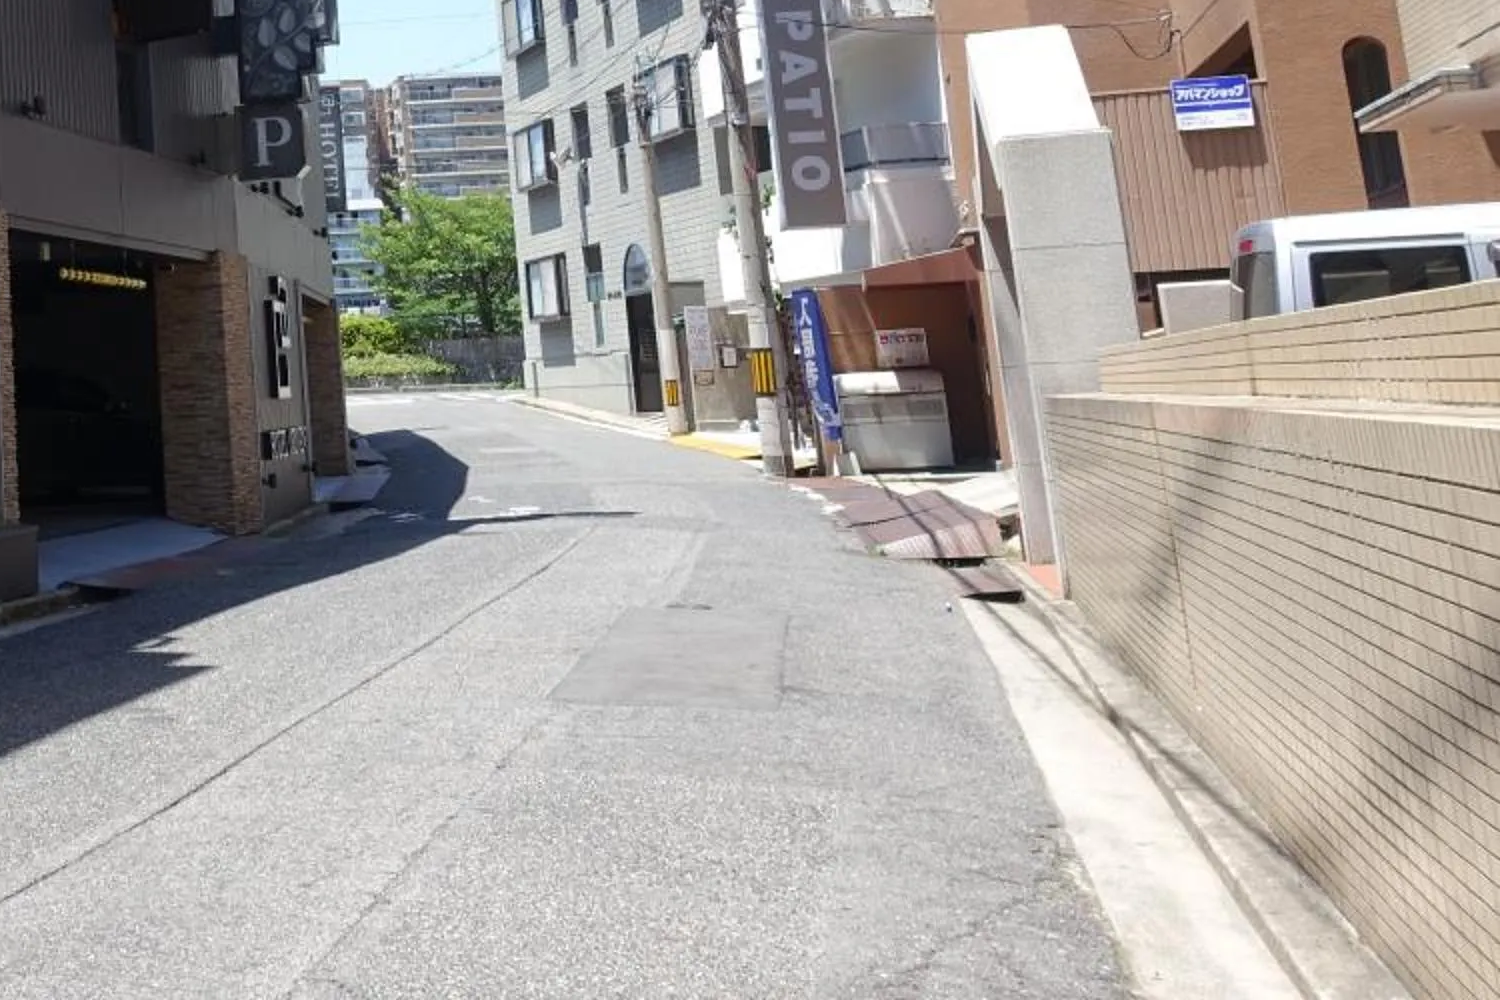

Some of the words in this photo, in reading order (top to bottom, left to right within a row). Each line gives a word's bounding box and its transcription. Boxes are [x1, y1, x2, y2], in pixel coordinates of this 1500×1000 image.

[775, 10, 832, 192] PATIO
[252, 117, 293, 168] P
[319, 123, 341, 198] HOTEL
